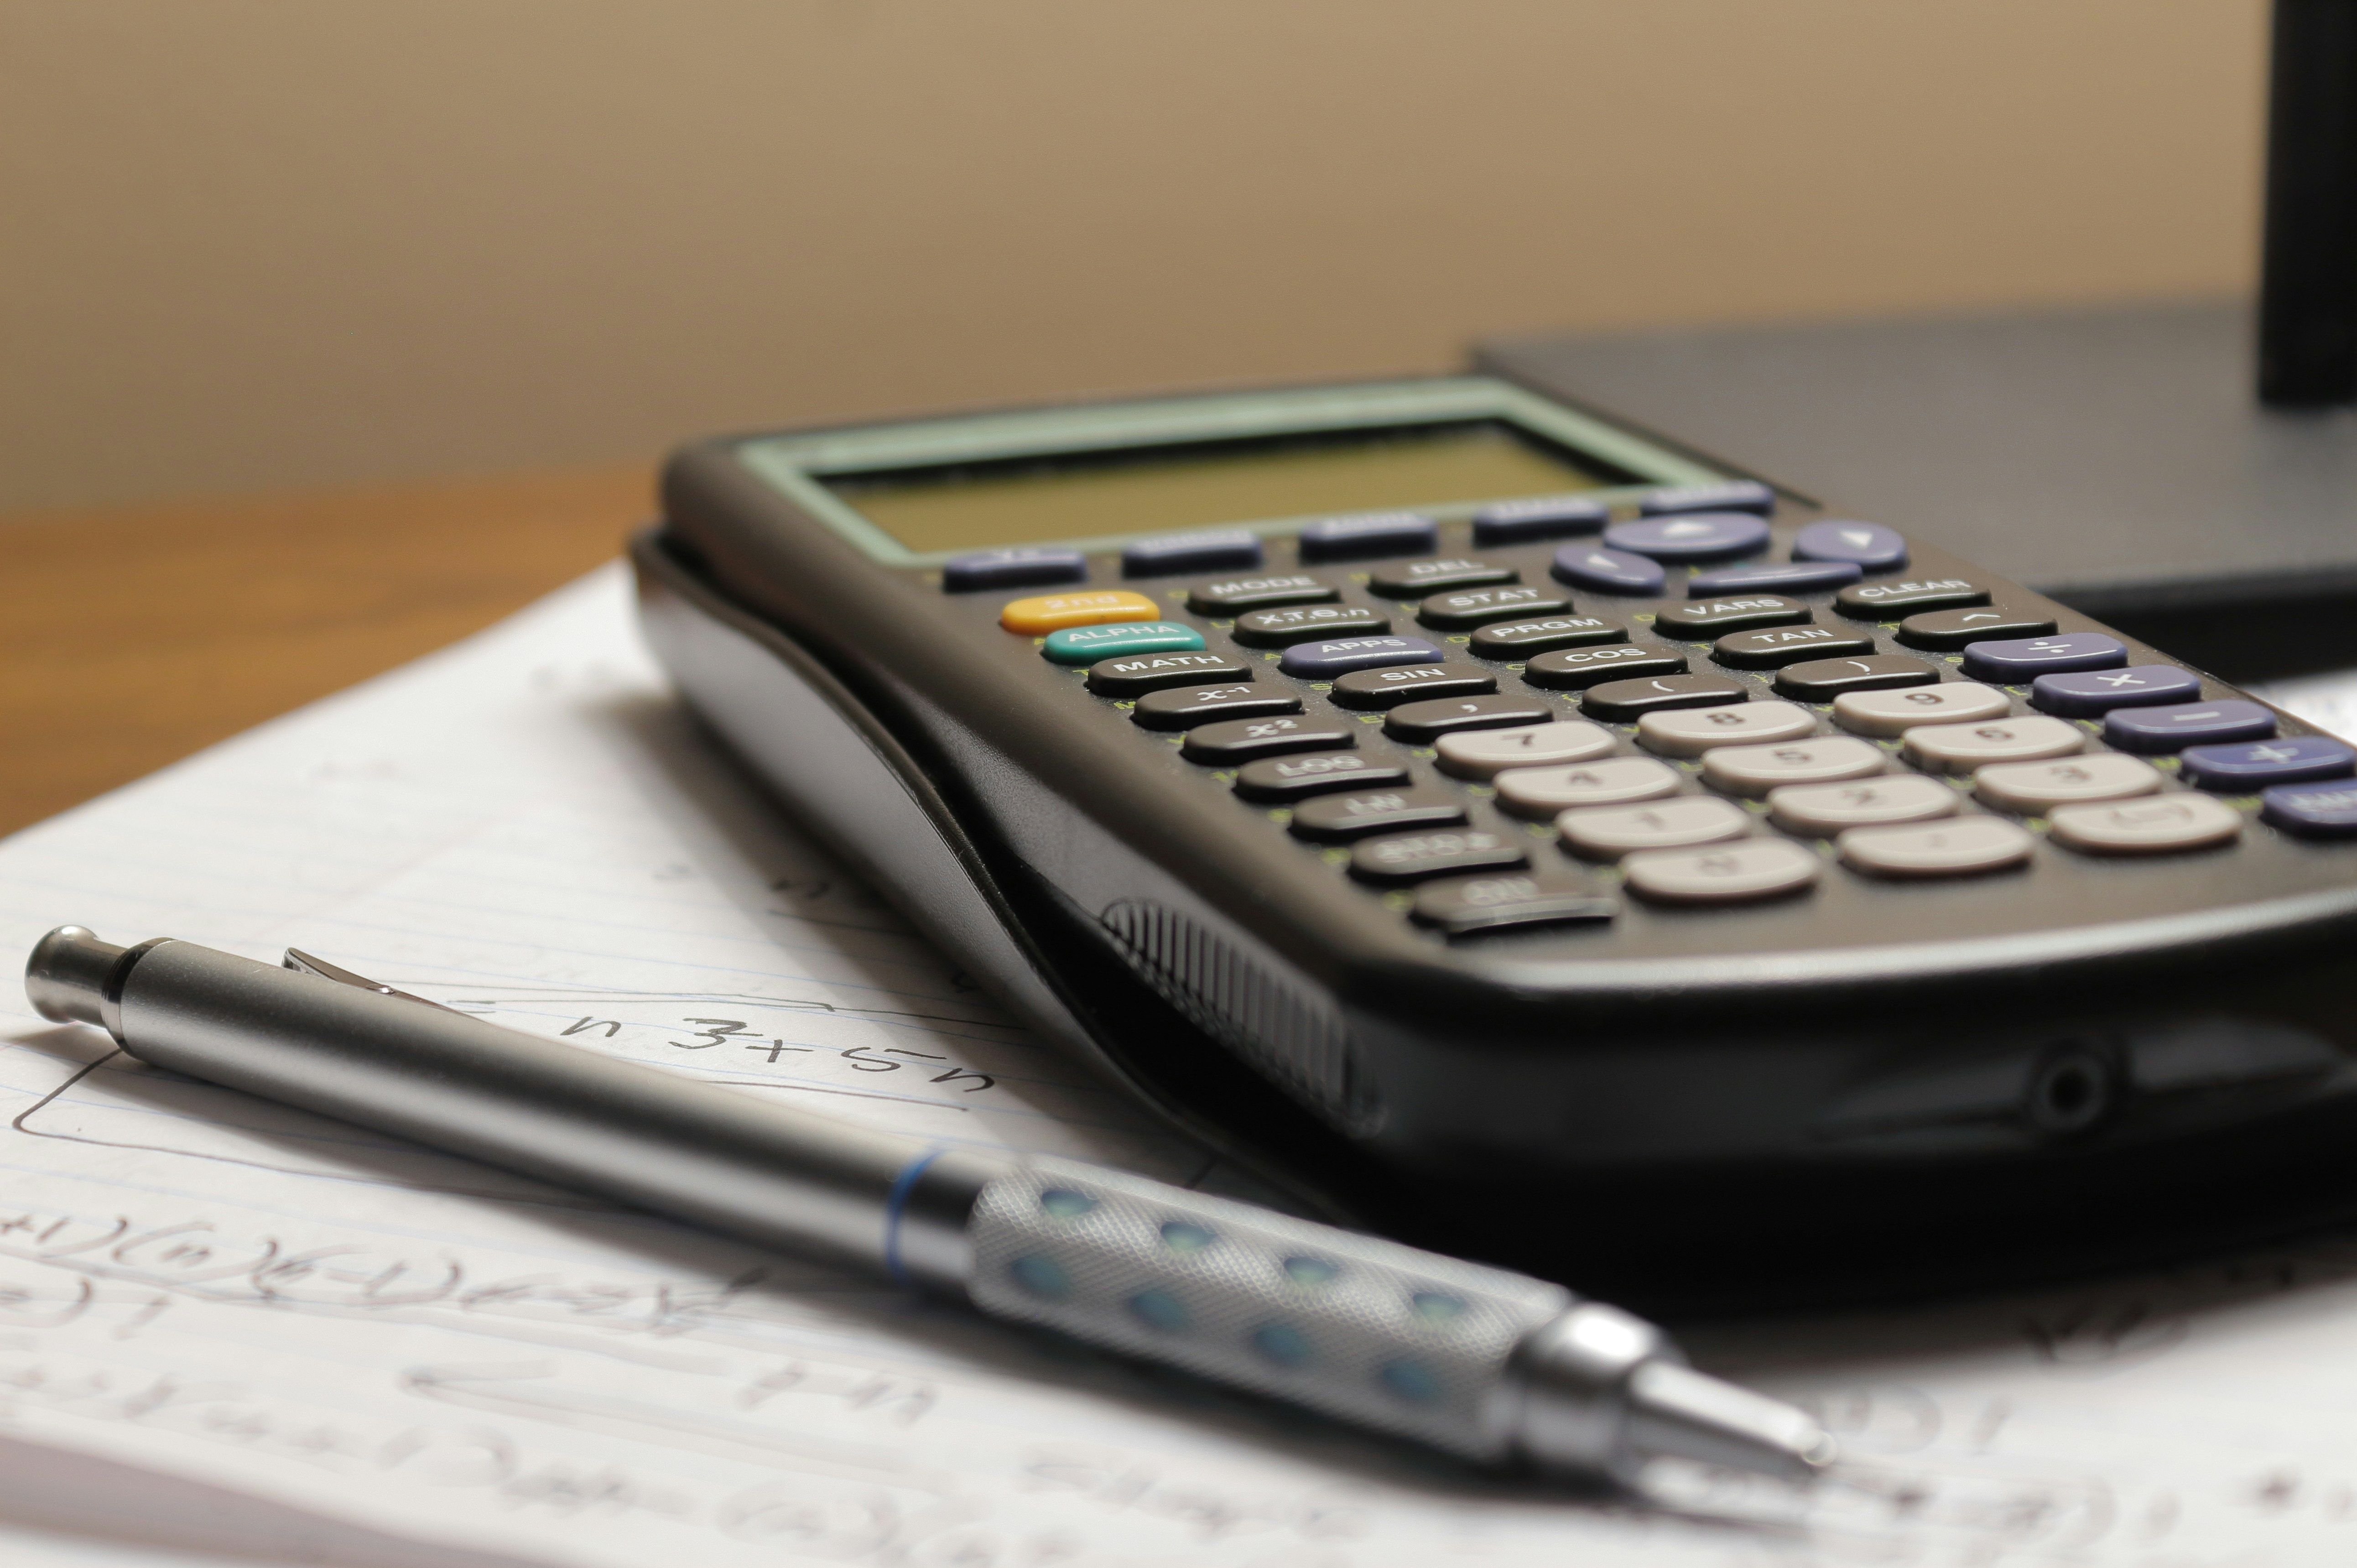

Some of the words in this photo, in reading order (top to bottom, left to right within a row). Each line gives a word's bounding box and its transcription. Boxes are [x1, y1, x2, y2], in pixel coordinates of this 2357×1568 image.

[1410, 559, 1484, 575] DEL
[1211, 576, 1317, 595] MODE
[1859, 578, 1972, 598] CLEAR
[1046, 594, 1118, 609] 2nd
[1449, 588, 1539, 607] STAT
[1684, 599, 1784, 616] VARS
[1068, 625, 1180, 642] ALPHA
[1491, 617, 1604, 637] PRGM
[1751, 629, 1835, 643] TAN
[1322, 638, 1408, 654] APPS
[1113, 655, 1225, 672] MATH
[1565, 648, 1647, 663] COS
[1380, 667, 1446, 681] SIN
[1904, 692, 1944, 706] 9
[1706, 712, 1746, 725] 8
[1501, 732, 1536, 747] 7
[1277, 755, 1365, 776] LOG
[1345, 793, 1407, 815] LN
